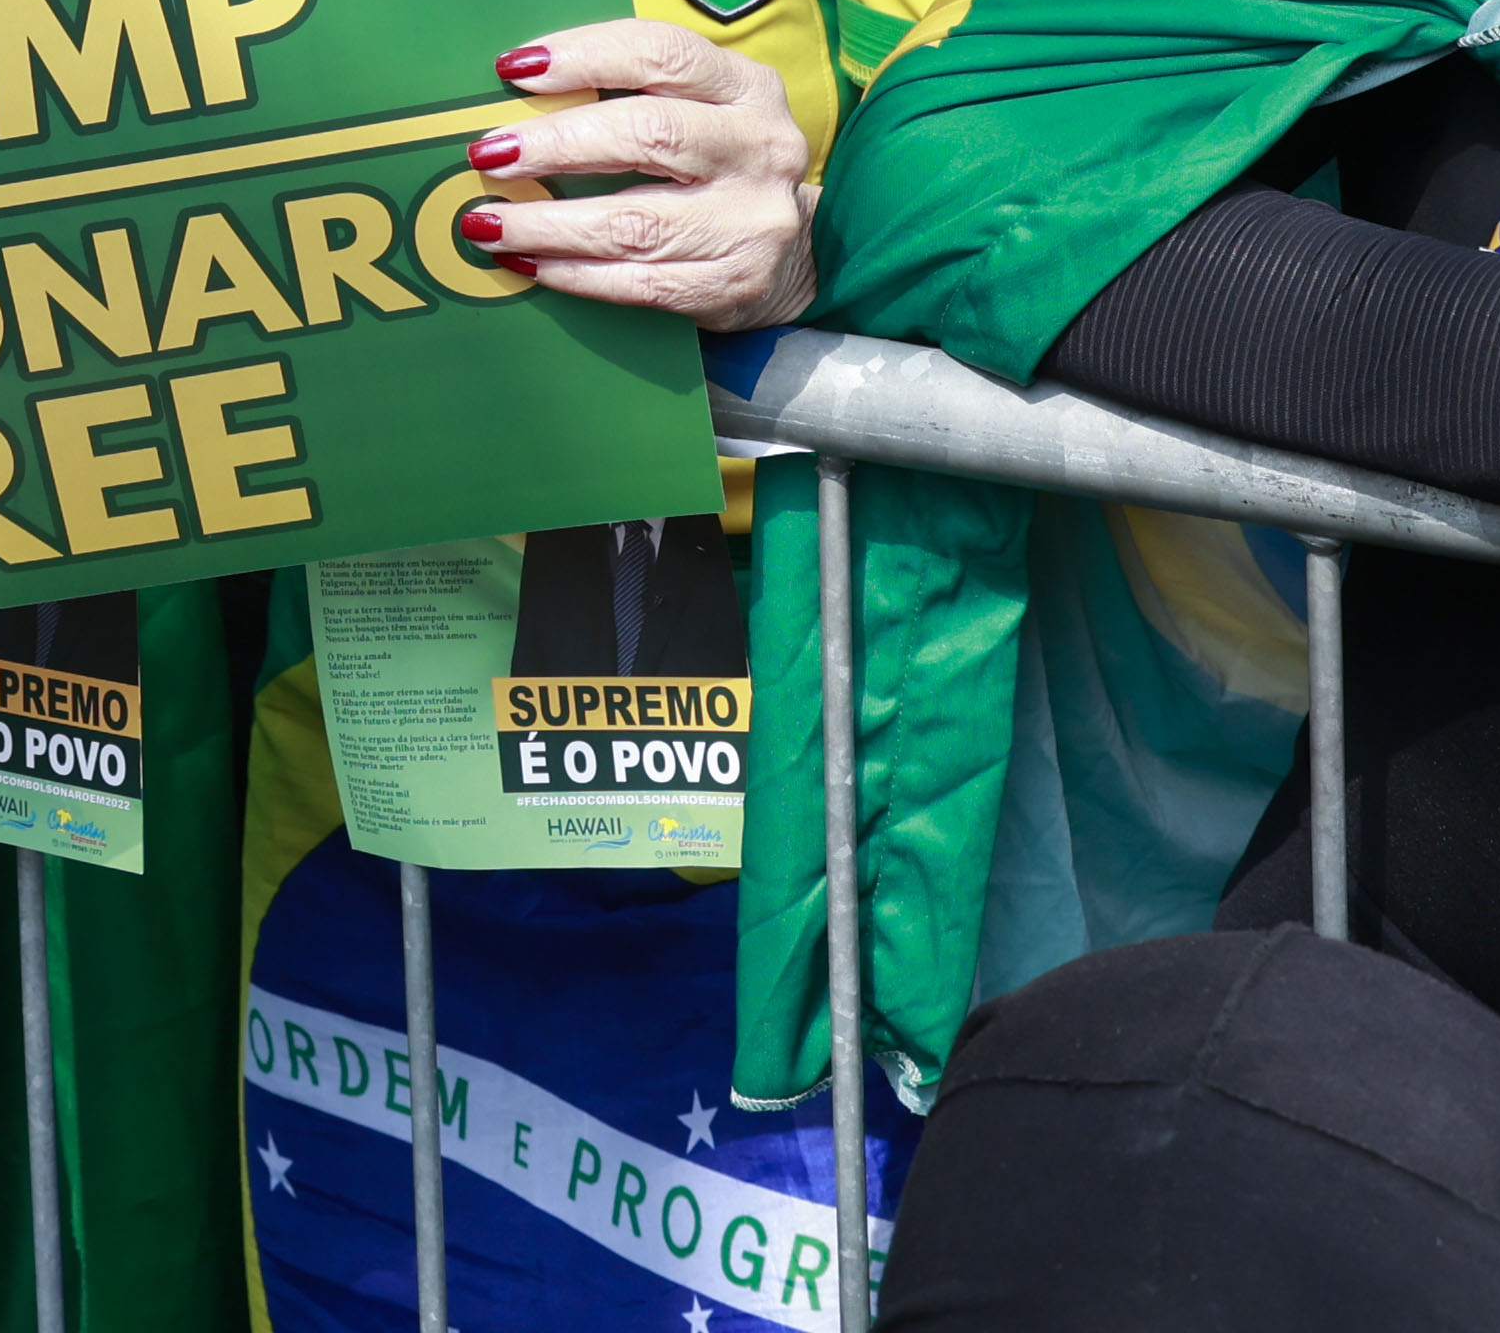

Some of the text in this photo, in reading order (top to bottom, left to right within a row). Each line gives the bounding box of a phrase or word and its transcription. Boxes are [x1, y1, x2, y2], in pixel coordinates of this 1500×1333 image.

[508, 685, 739, 728] SUPREMO
[25, 727, 127, 787] POVO
[519, 732, 741, 785] É O POVO
[547, 817, 622, 836] HAWAII
[248, 1007, 850, 1315] ORDEM E PROGR
